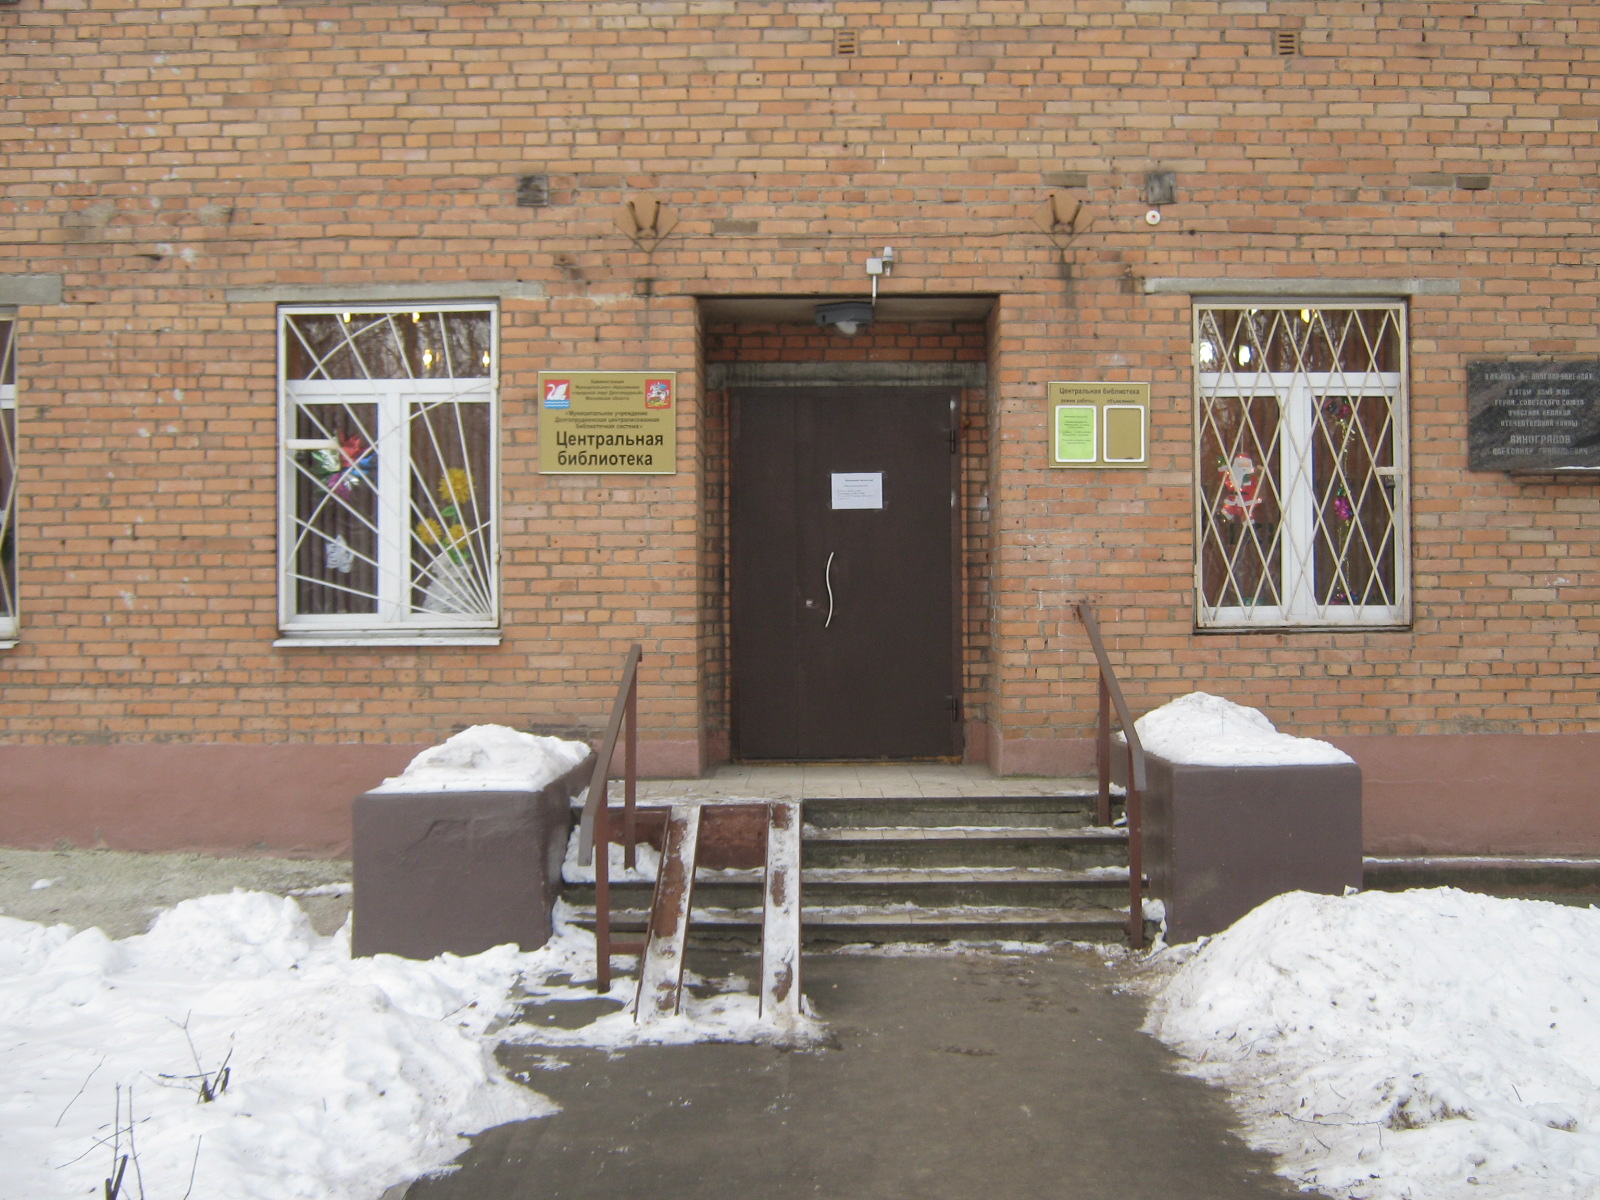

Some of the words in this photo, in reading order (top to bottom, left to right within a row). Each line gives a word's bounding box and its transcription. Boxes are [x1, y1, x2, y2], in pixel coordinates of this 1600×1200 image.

[1059, 387, 1101, 396] Центральная
[1102, 387, 1140, 395] библиотека
[556, 431, 664, 449] Центральная
[1509, 434, 1571, 444] ВИНОГРАДОВ
[557, 450, 653, 466] библиотека
